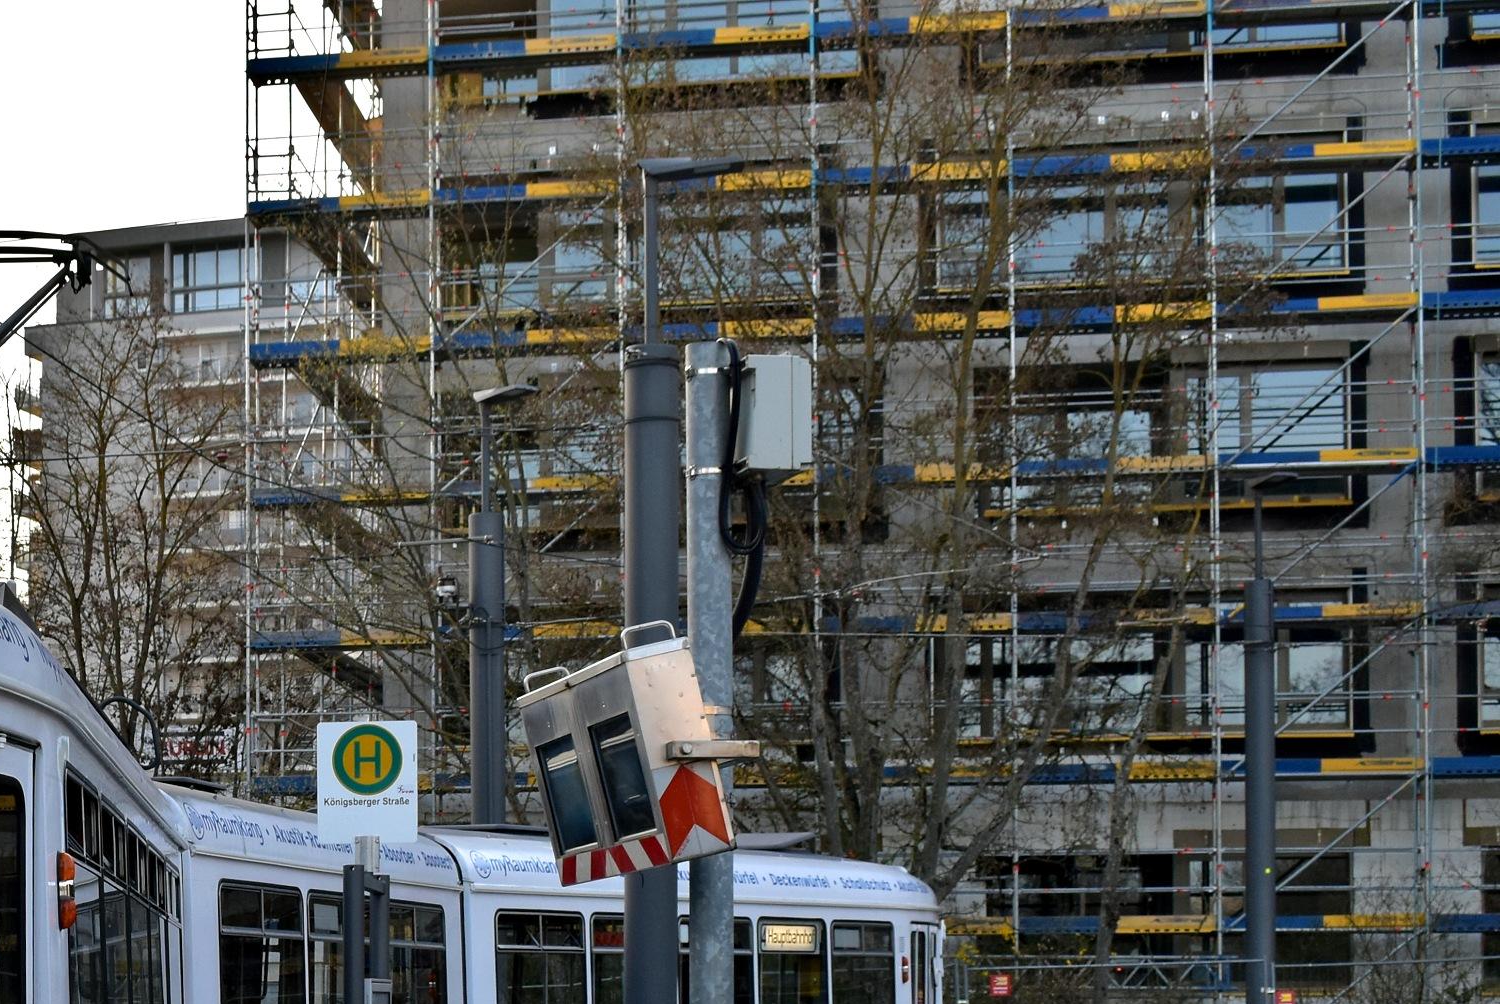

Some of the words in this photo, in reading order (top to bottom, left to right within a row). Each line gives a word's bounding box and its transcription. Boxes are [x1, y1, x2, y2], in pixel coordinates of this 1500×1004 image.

[323, 797, 380, 807] Königsberger
[382, 797, 410, 806] Straße
[201, 809, 264, 845] myRaumklang
[490, 855, 557, 877] myRaumklan
[769, 873, 830, 889] Deckenwürfel
